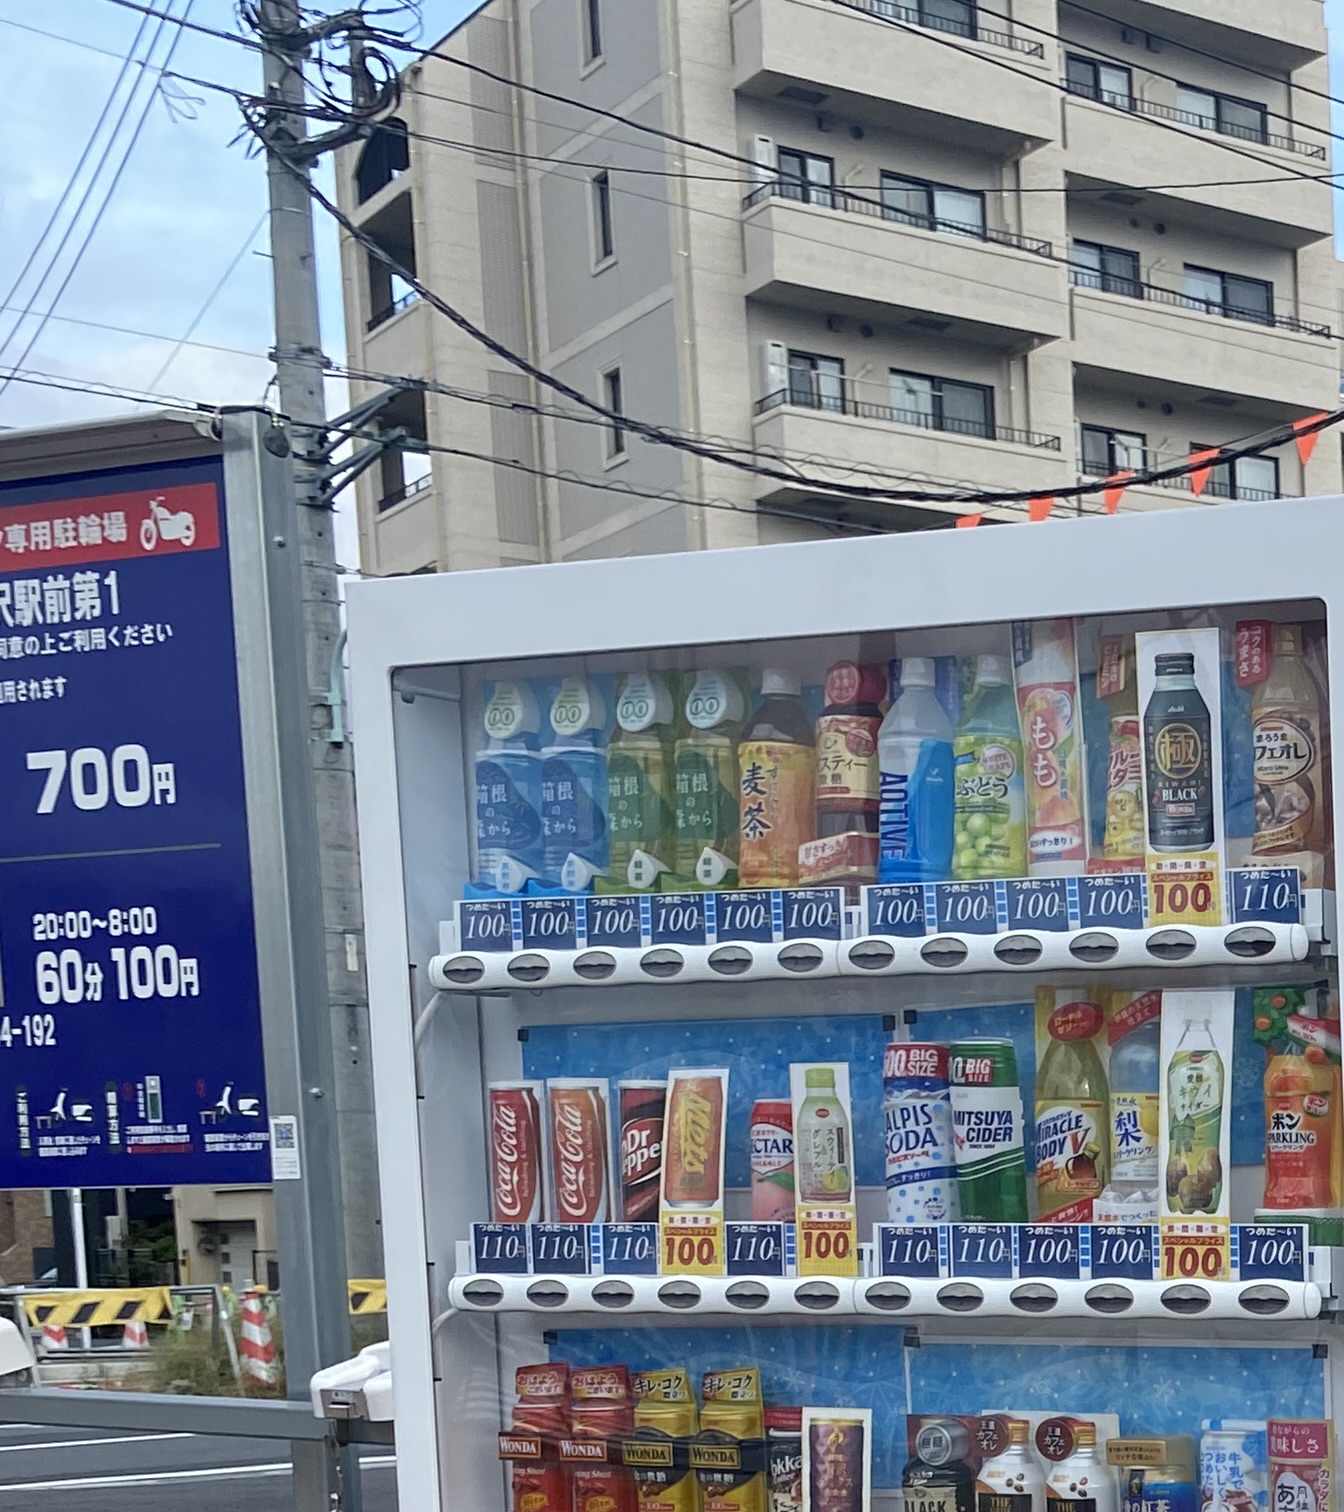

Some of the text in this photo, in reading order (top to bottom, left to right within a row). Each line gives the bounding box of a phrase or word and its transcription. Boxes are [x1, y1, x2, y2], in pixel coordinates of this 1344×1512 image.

[0, 511, 127, 552] 専用駐輪場
[1030, 716, 1057, 788] もも
[1162, 731, 1196, 771] 極
[26, 744, 176, 814] 700円
[956, 777, 1009, 798] ぶどう
[741, 761, 772, 841] 麦茶
[1162, 788, 1198, 801] BLACK
[36, 944, 199, 1005] 60分 100円
[909, 1049, 938, 1062] BIG
[907, 1062, 936, 1077] SIZE
[966, 1058, 991, 1074] BIG
[968, 1073, 990, 1083] SIZE
[953, 1110, 1013, 1127] MITSUYA
[966, 1126, 1013, 1143] CIDER
[1114, 1110, 1142, 1147] 梨
[976, 1430, 999, 1441] カフェ
[1044, 1436, 1065, 1446] カフェ
[499, 1437, 537, 1454] WONDA
[560, 1439, 602, 1457] WONDA
[981, 1441, 998, 1452] オレ
[1047, 1445, 1064, 1455] オレ
[627, 1448, 667, 1461] WONDA
[693, 1449, 735, 1462] WONDA
